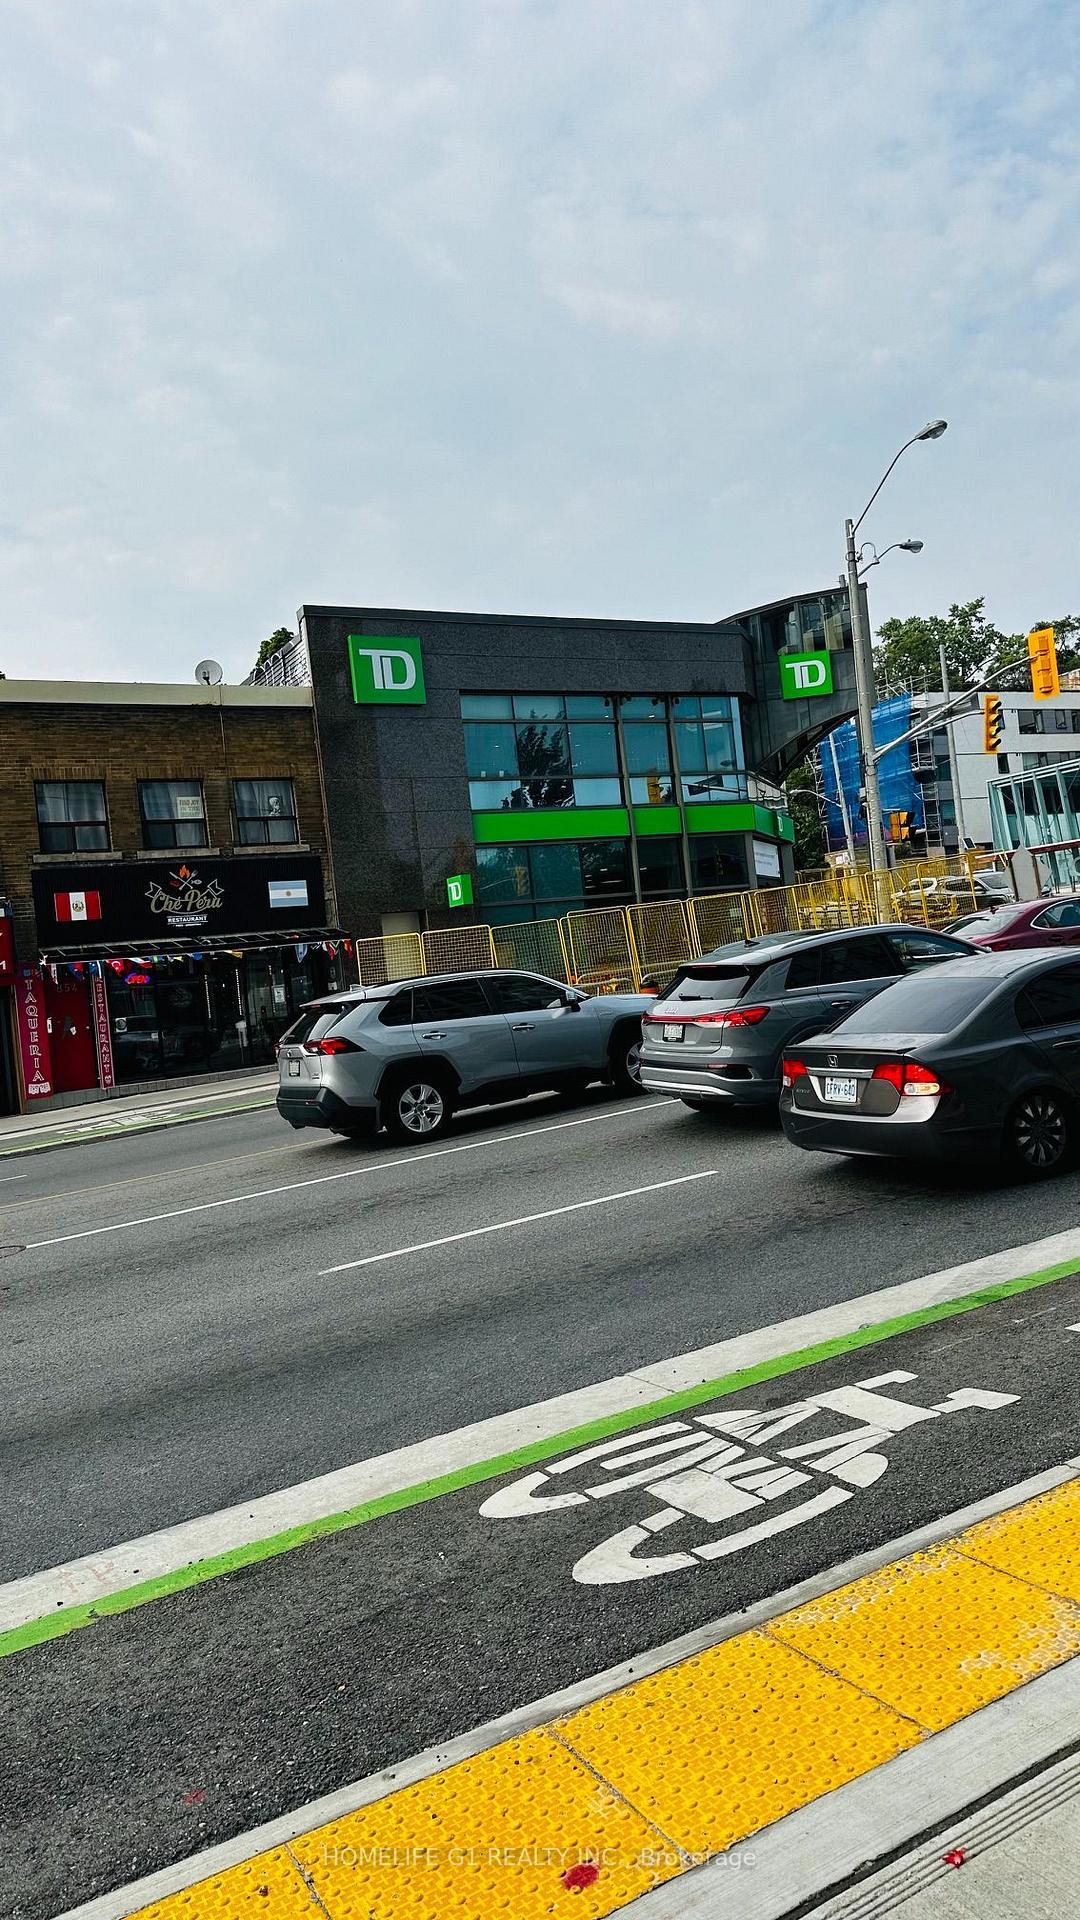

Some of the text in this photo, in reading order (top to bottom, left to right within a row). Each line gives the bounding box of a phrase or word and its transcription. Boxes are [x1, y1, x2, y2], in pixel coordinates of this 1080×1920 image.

[359, 649, 416, 689] TD
[785, 660, 826, 688] TD
[448, 882, 461, 900] TD
[167, 915, 208, 923] RESTAURANT
[25, 979, 45, 1082] TAQUERIA
[95, 976, 111, 1073] RESTAURANT
